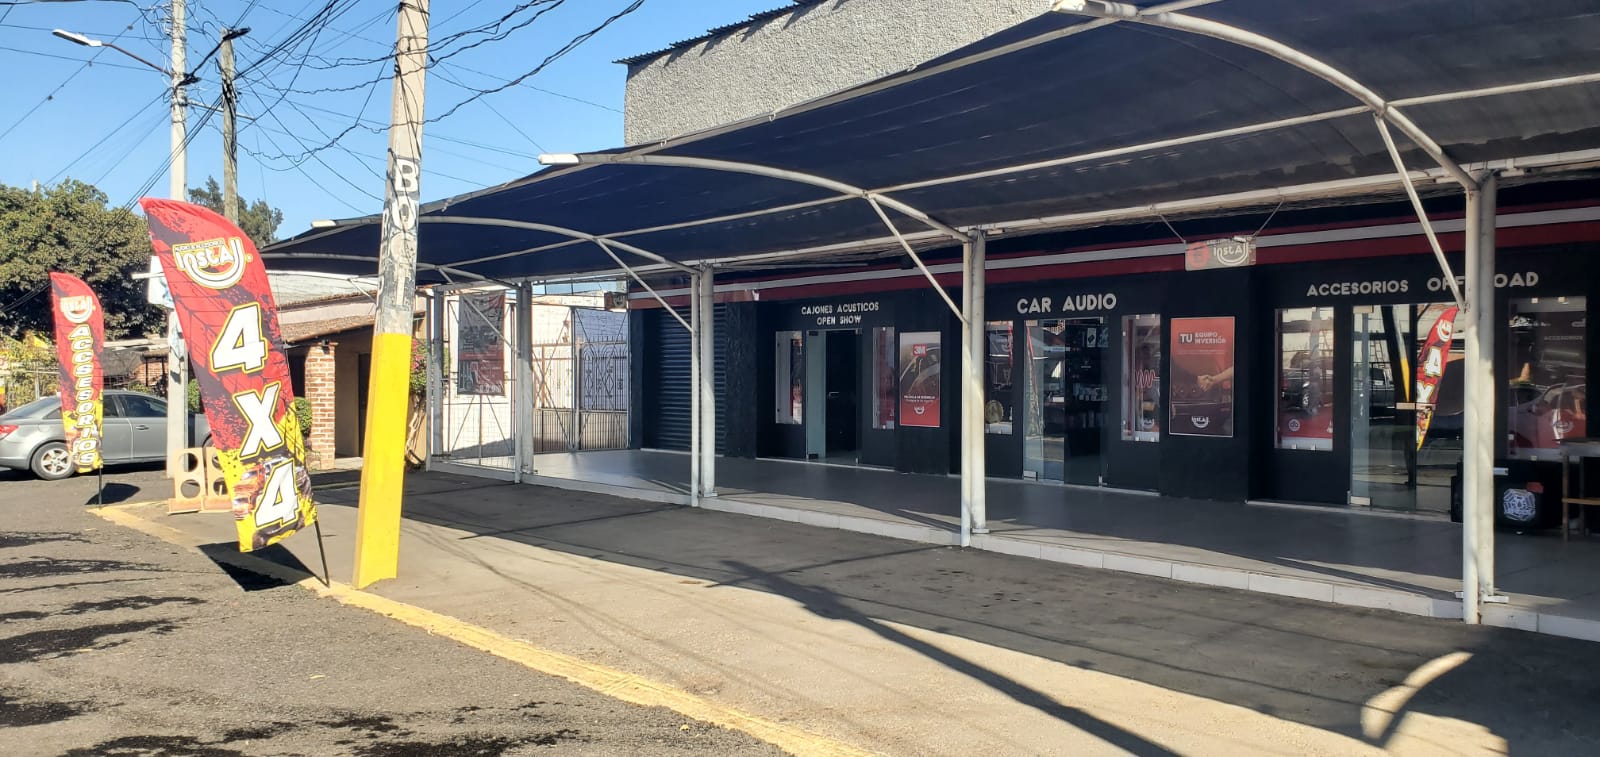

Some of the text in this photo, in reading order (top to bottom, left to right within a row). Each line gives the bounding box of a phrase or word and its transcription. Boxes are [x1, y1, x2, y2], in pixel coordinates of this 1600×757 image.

[1306, 280, 1409, 297] ACCESORIOS
[1494, 271, 1539, 288] OAD
[801, 302, 879, 315] CAJONES ACUSTICOS
[1017, 293, 1117, 314] CAR AUDIO
[816, 315, 861, 325] OPEN SHOW
[211, 303, 268, 374] 4
[1180, 333, 1193, 343] TU
[69, 325, 98, 464] ACCESORIOS
[254, 460, 299, 529] 4
